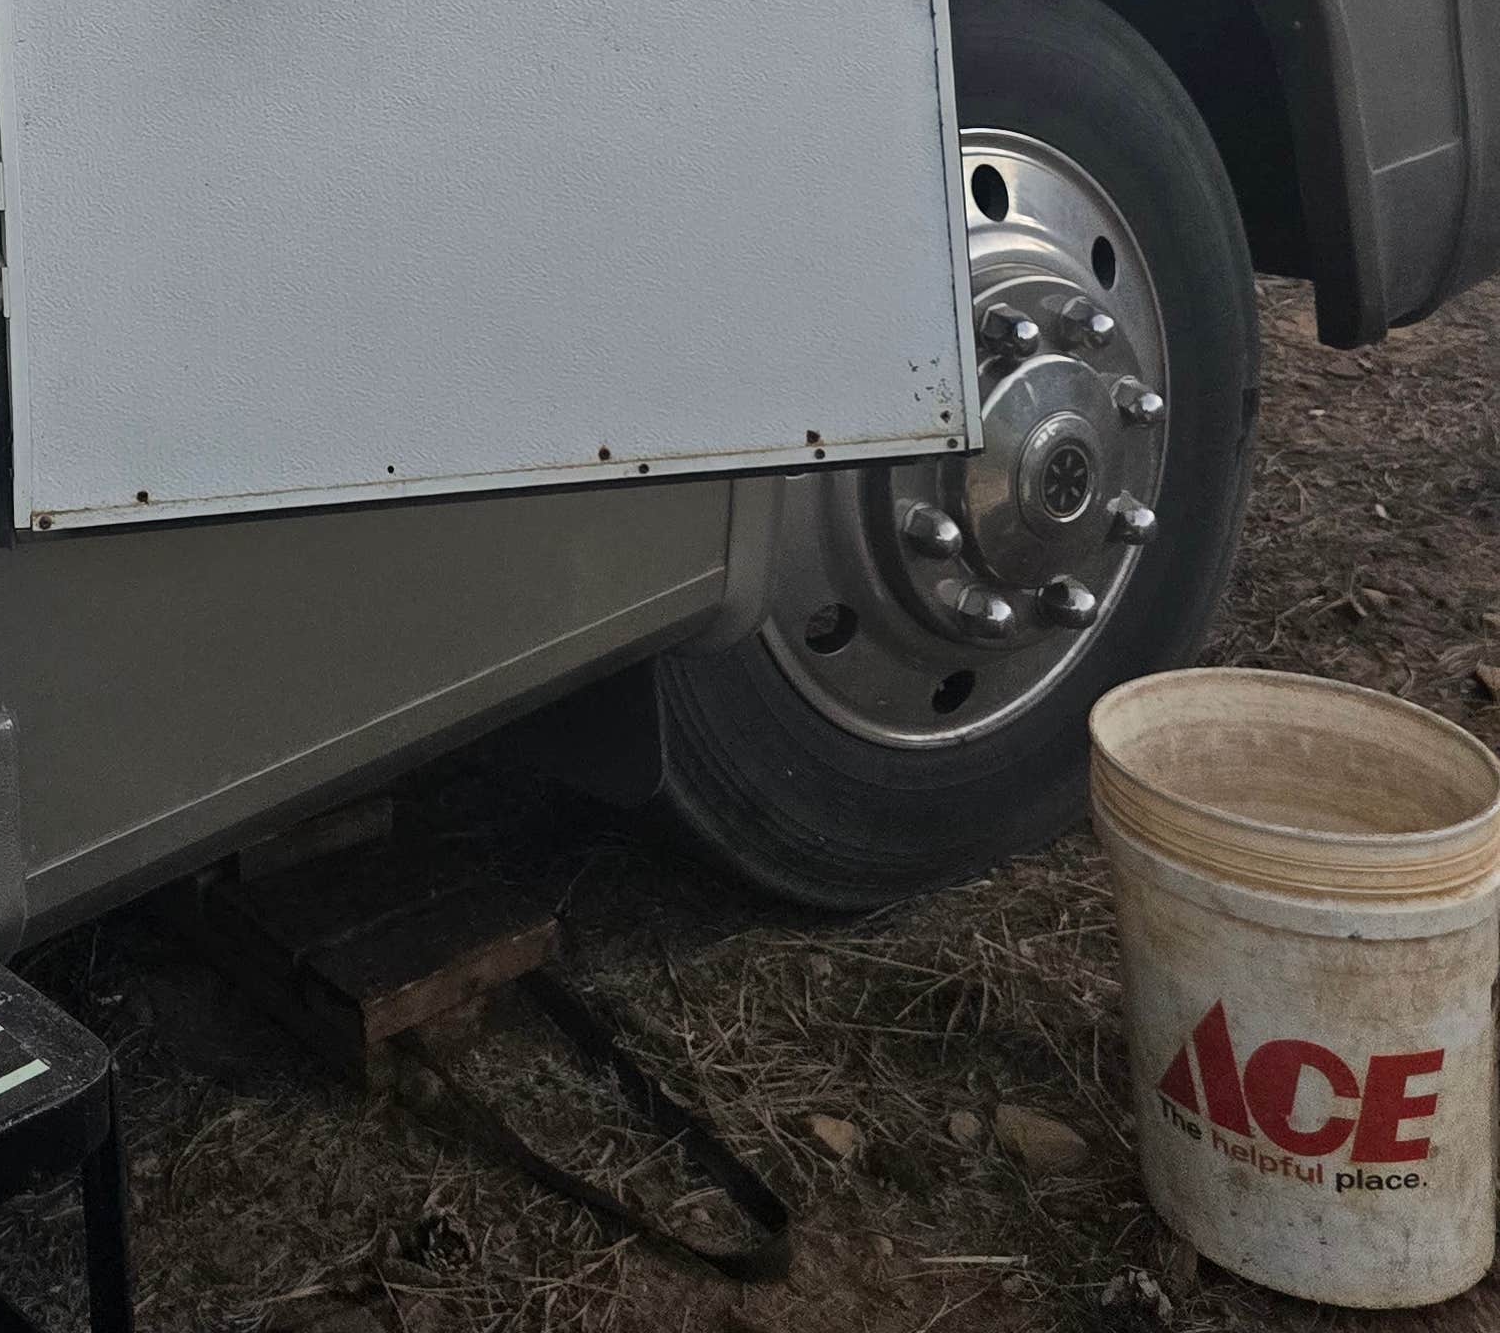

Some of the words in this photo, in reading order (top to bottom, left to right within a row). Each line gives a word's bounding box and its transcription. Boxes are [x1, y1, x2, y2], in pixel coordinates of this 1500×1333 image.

[1157, 998, 1445, 1163] ACE
[1158, 1094, 1202, 1140] The
[1211, 1129, 1324, 1184] helpful
[1336, 1169, 1428, 1193] place.
